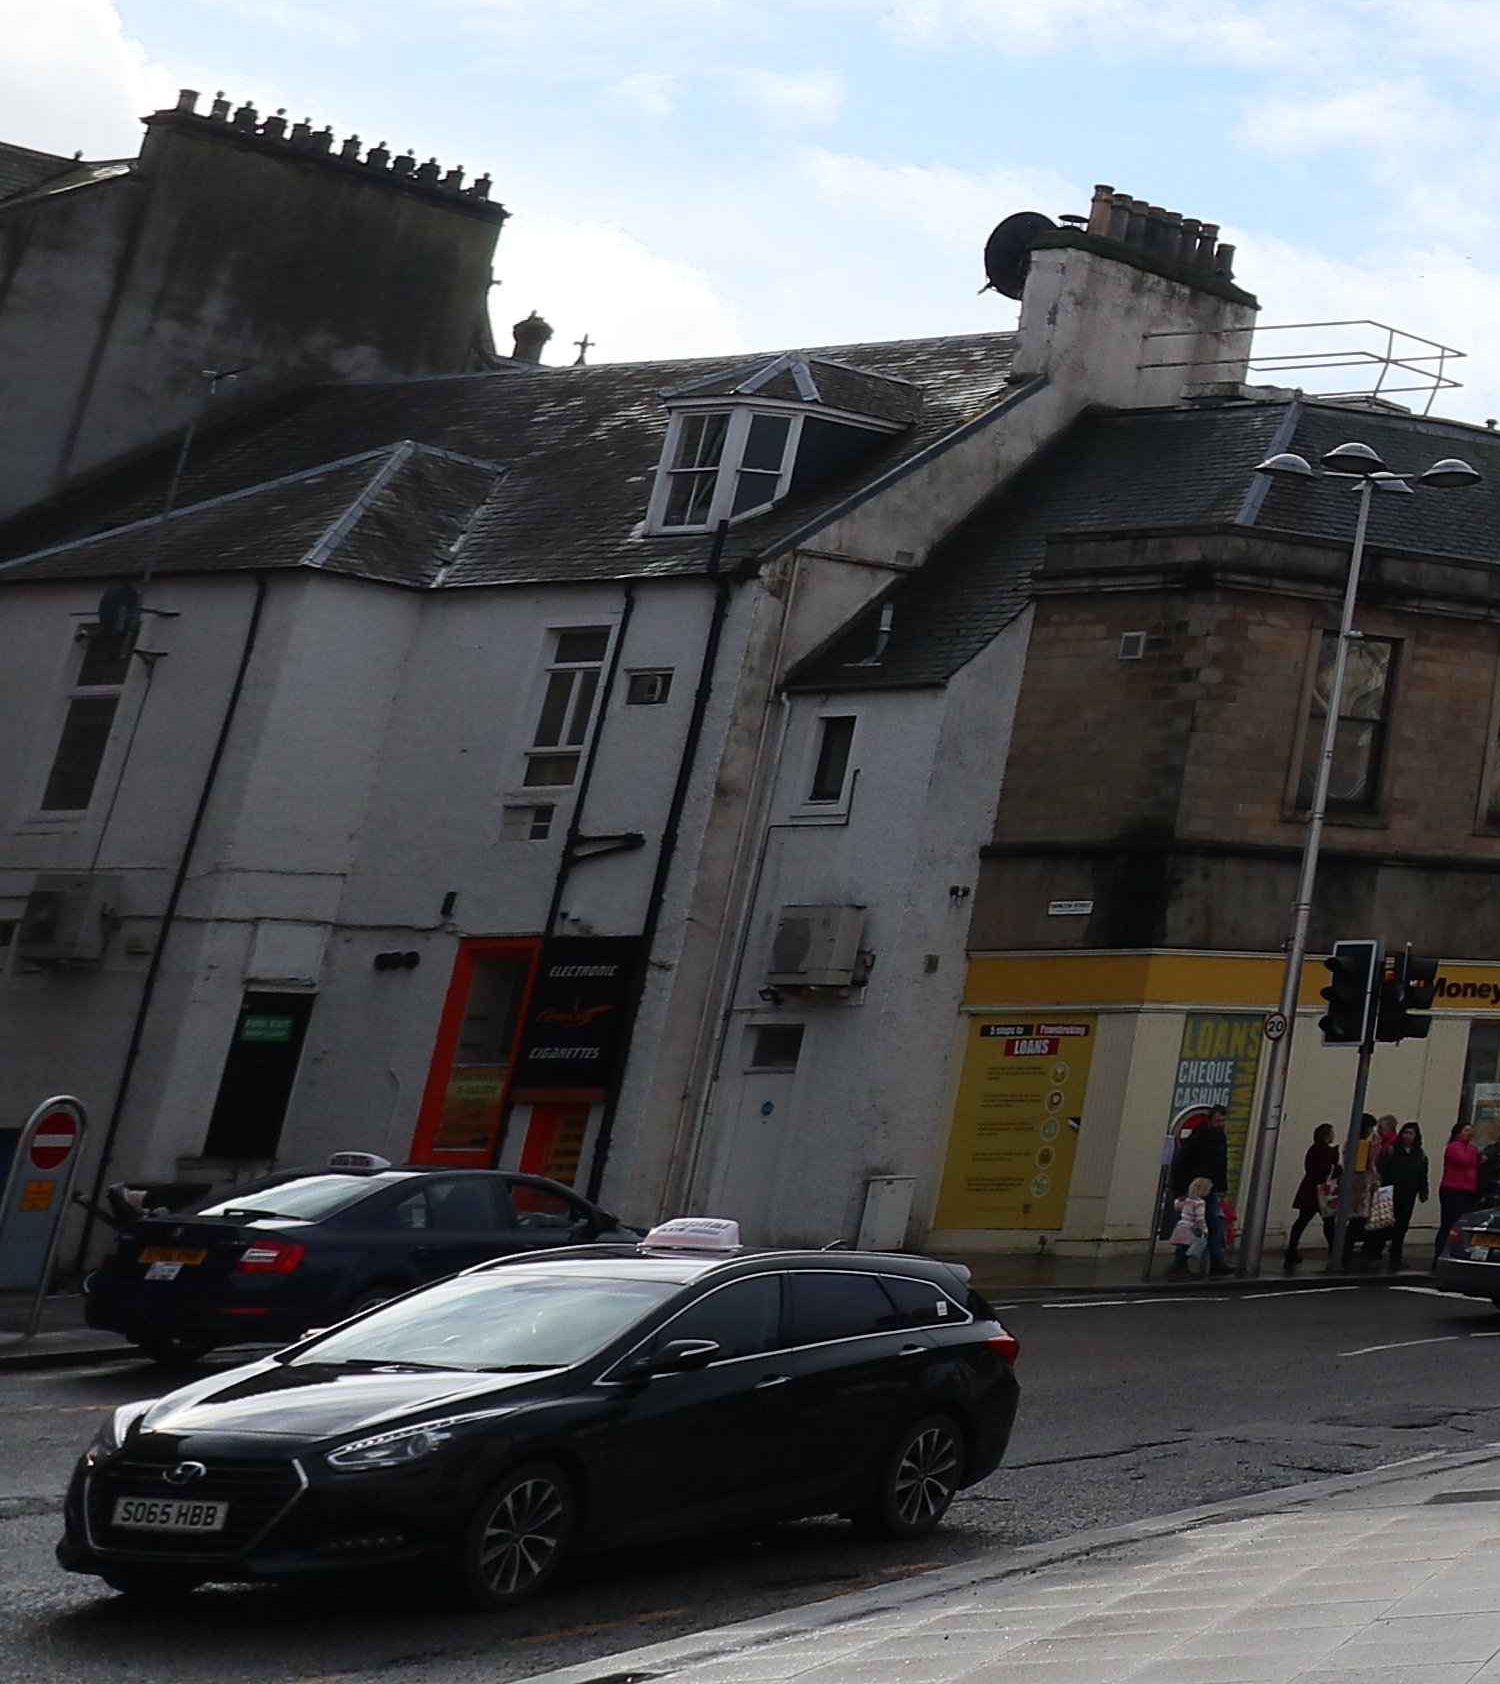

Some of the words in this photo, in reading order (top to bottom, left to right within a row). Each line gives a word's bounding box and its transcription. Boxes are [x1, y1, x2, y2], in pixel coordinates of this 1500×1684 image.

[549, 965, 619, 977] ELECTRONIC
[1268, 1020, 1285, 1033] 20
[1013, 1039, 1051, 1055] LOANS
[1183, 1020, 1263, 1058] LOANS
[528, 1047, 600, 1059] CIGARETTES
[1177, 1061, 1234, 1085] CHEQUE
[1174, 1087, 1231, 1109] CASHING
[174, 1504, 218, 1527] HBB
